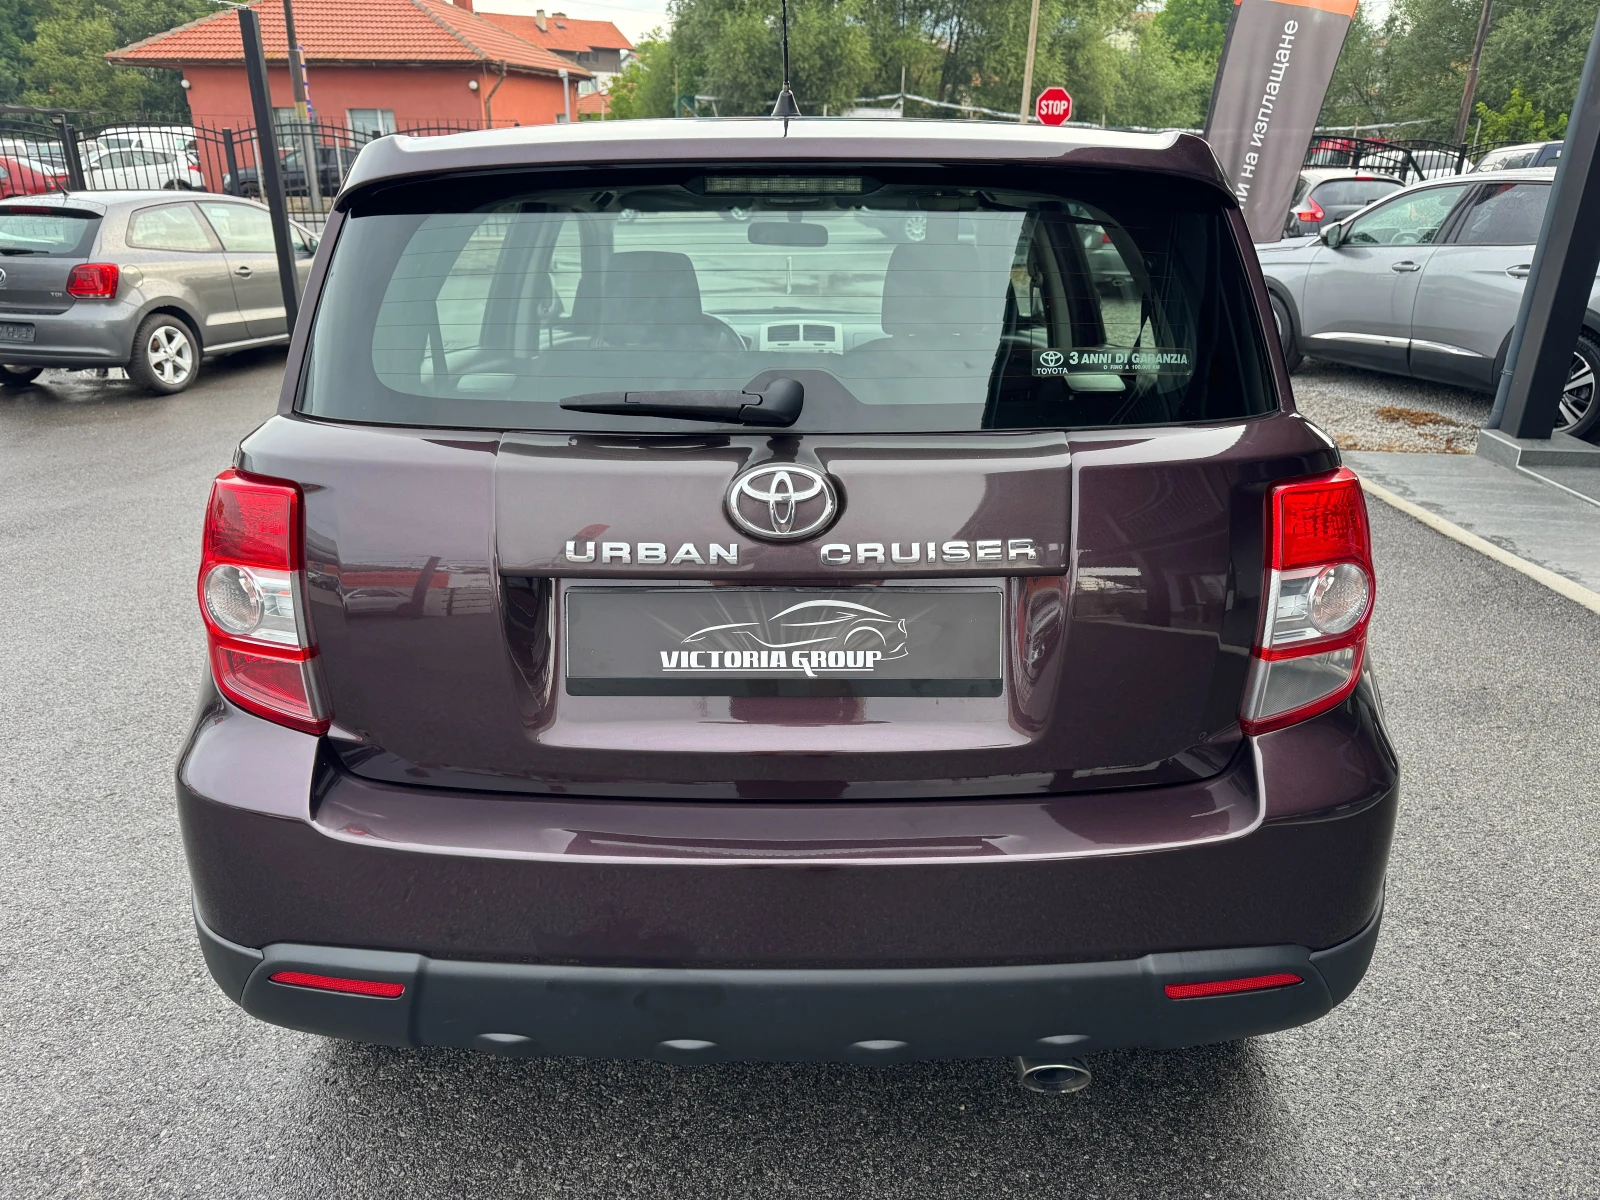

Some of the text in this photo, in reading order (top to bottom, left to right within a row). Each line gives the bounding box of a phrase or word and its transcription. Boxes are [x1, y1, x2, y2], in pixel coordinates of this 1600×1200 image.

[1040, 99, 1069, 115] STOP
[1235, 20, 1299, 210] и на изплащане
[1069, 351, 1188, 364] 3 ANNI DI GARANZIA
[1036, 367, 1069, 375] TOYOTA
[565, 539, 1037, 565] URBAN CRUISER
[660, 650, 882, 677] VICTORIA GROUP
